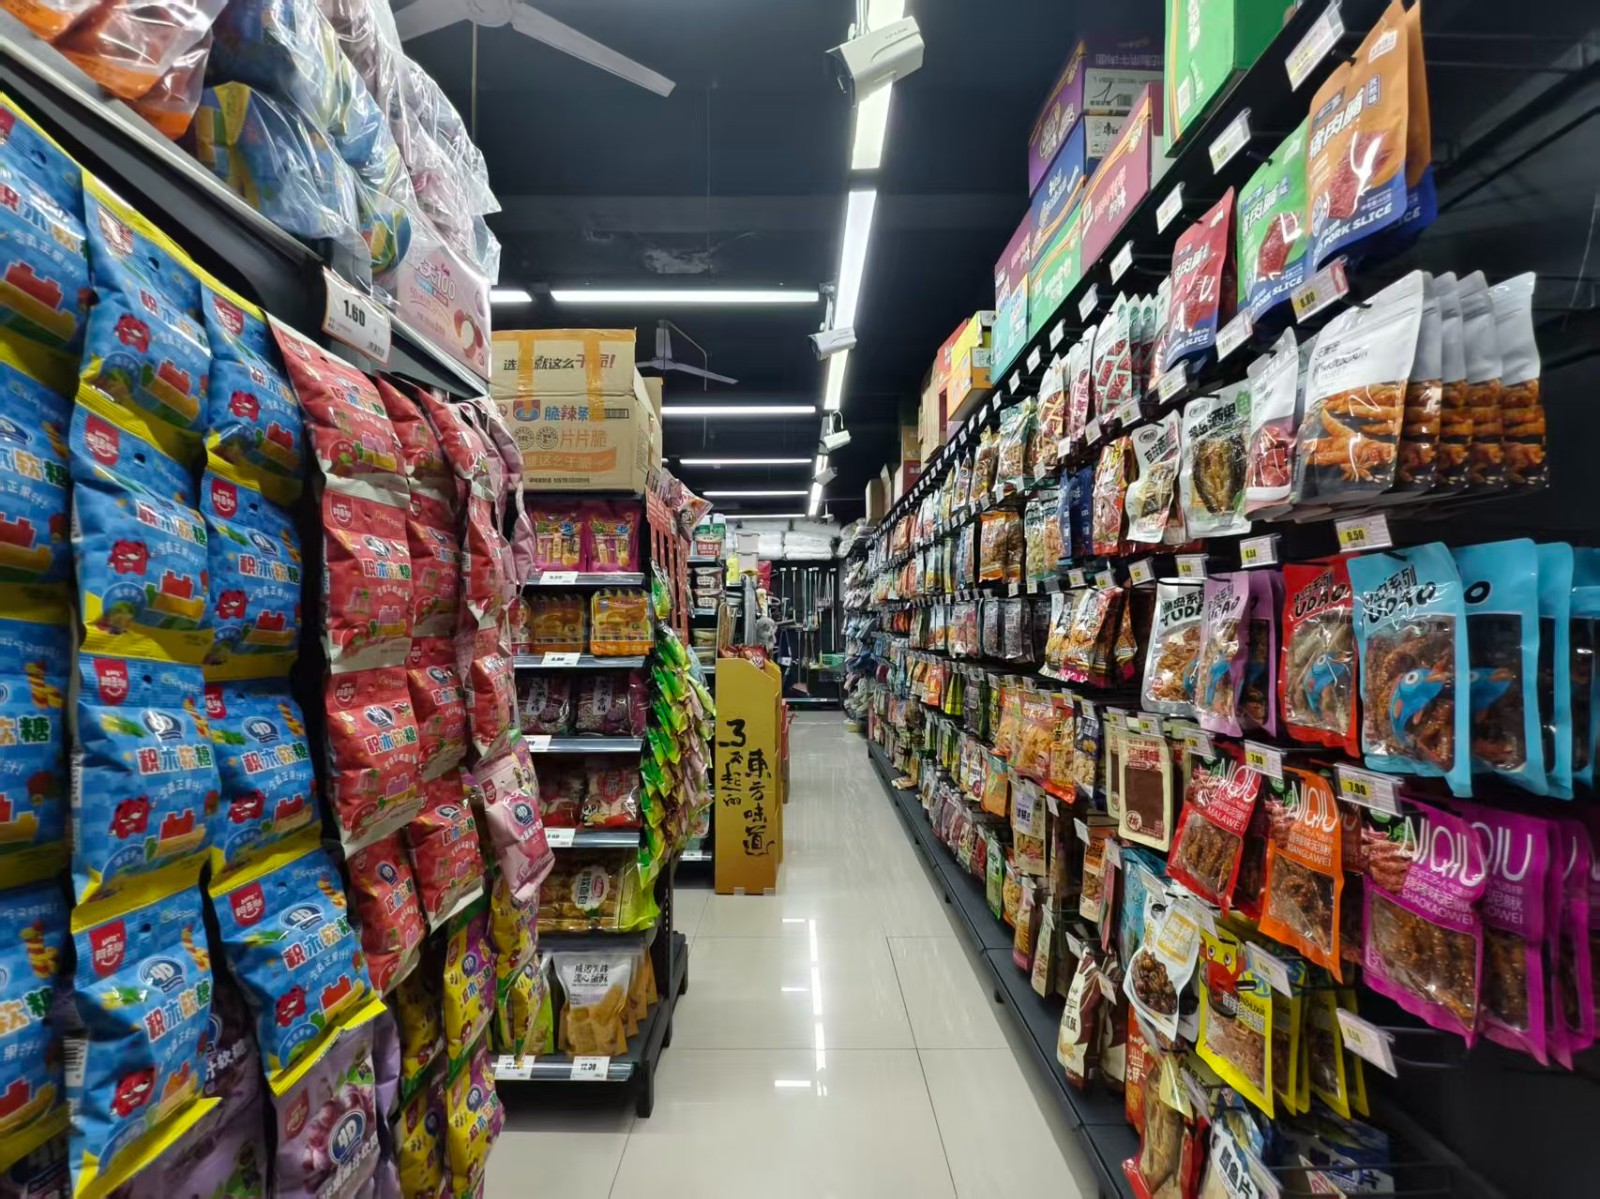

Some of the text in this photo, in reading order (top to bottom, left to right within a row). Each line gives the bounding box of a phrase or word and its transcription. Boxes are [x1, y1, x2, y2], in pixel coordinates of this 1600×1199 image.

[1353, 203, 1394, 231] SLICE
[1273, 276, 1304, 297] SLICE
[343, 299, 366, 327] 1.60
[1348, 782, 1367, 796] 7.90
